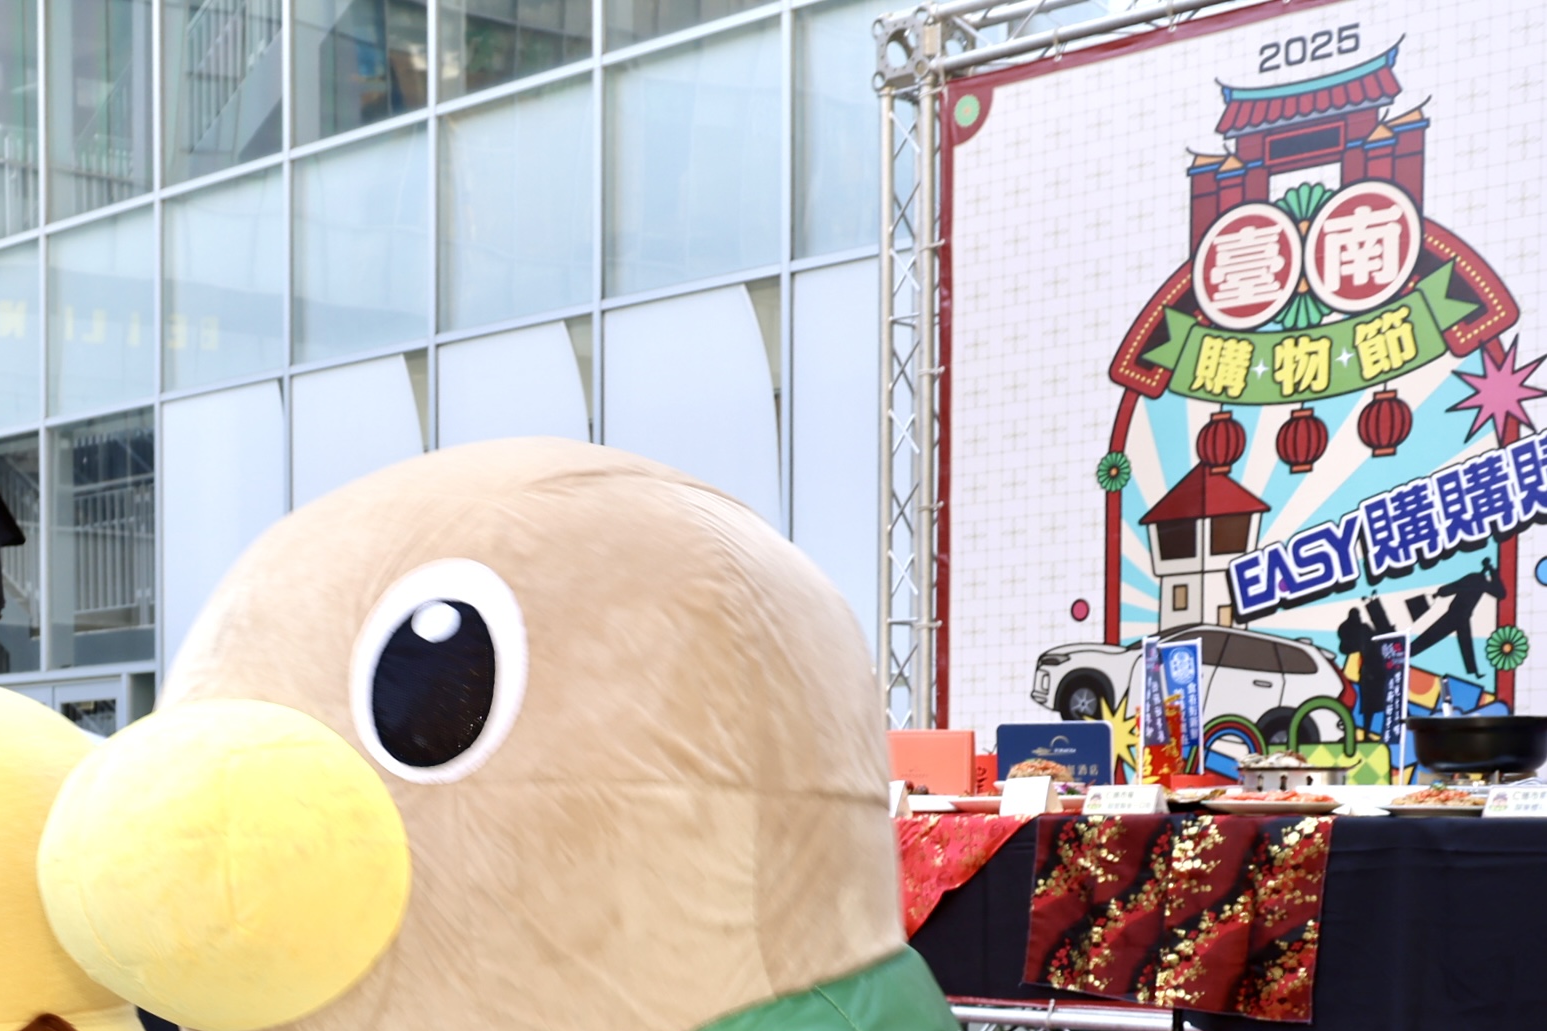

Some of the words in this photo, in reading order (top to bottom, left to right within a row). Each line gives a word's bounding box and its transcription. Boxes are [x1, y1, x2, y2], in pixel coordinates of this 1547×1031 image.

[1258, 22, 1360, 74] 2025
[1209, 204, 1404, 310] 臺南
[1189, 305, 1418, 398] 購物節
